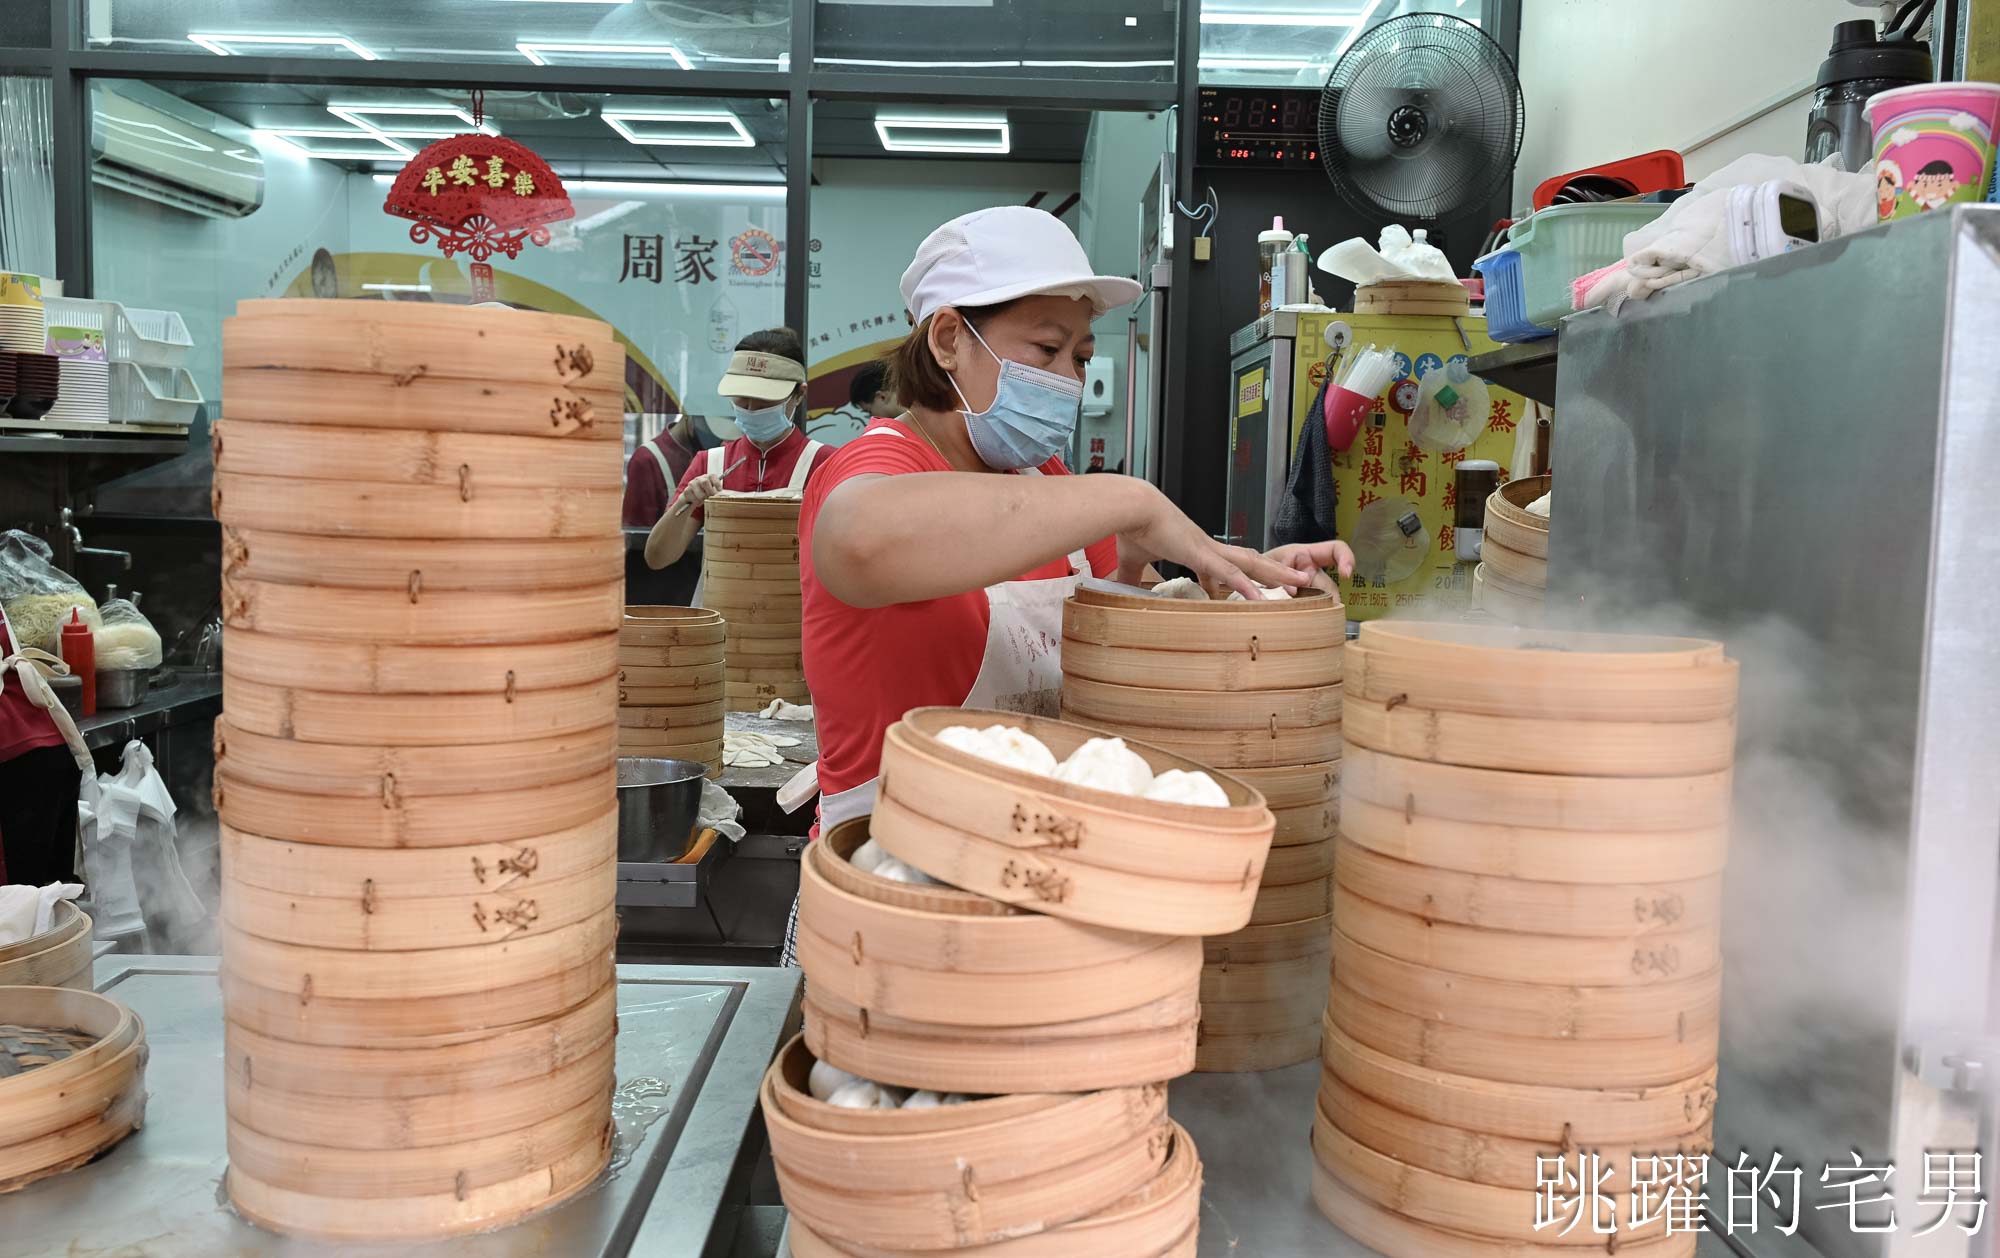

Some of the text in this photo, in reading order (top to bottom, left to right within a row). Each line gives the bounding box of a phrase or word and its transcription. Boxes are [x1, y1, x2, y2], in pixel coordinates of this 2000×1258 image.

[421, 154, 535, 196] 平安喜樂
[619, 234, 719, 284] 周家
